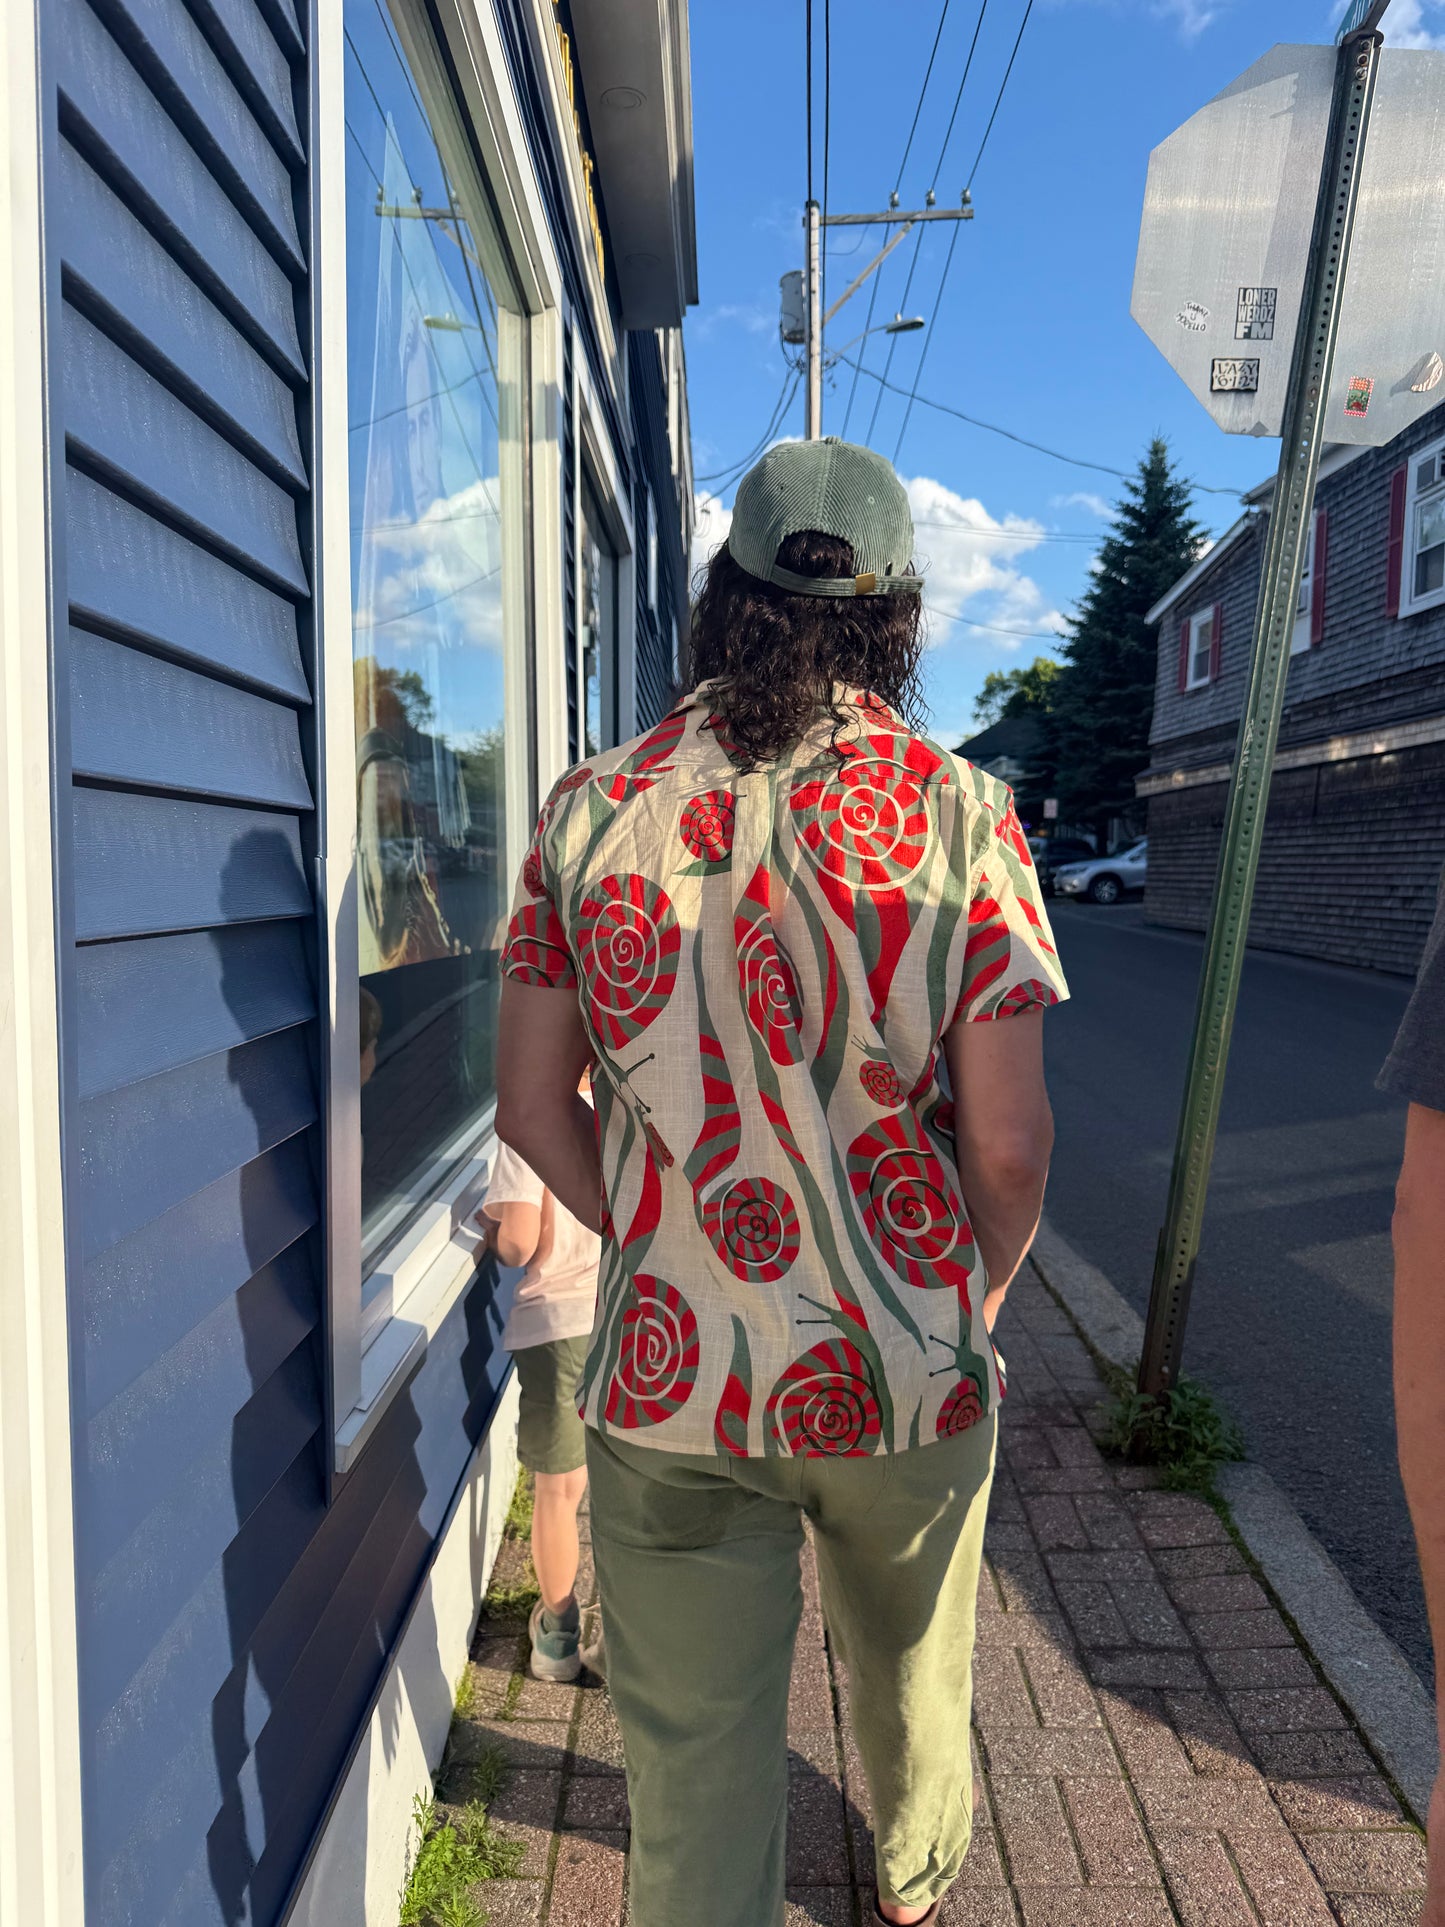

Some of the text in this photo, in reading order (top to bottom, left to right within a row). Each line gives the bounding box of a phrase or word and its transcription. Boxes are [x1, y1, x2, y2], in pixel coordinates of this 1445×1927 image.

[1239, 288, 1275, 305] LONER
[1238, 305, 1275, 322] WERDZ
[1236, 322, 1273, 339] FM
[1218, 362, 1256, 376] LAZY
